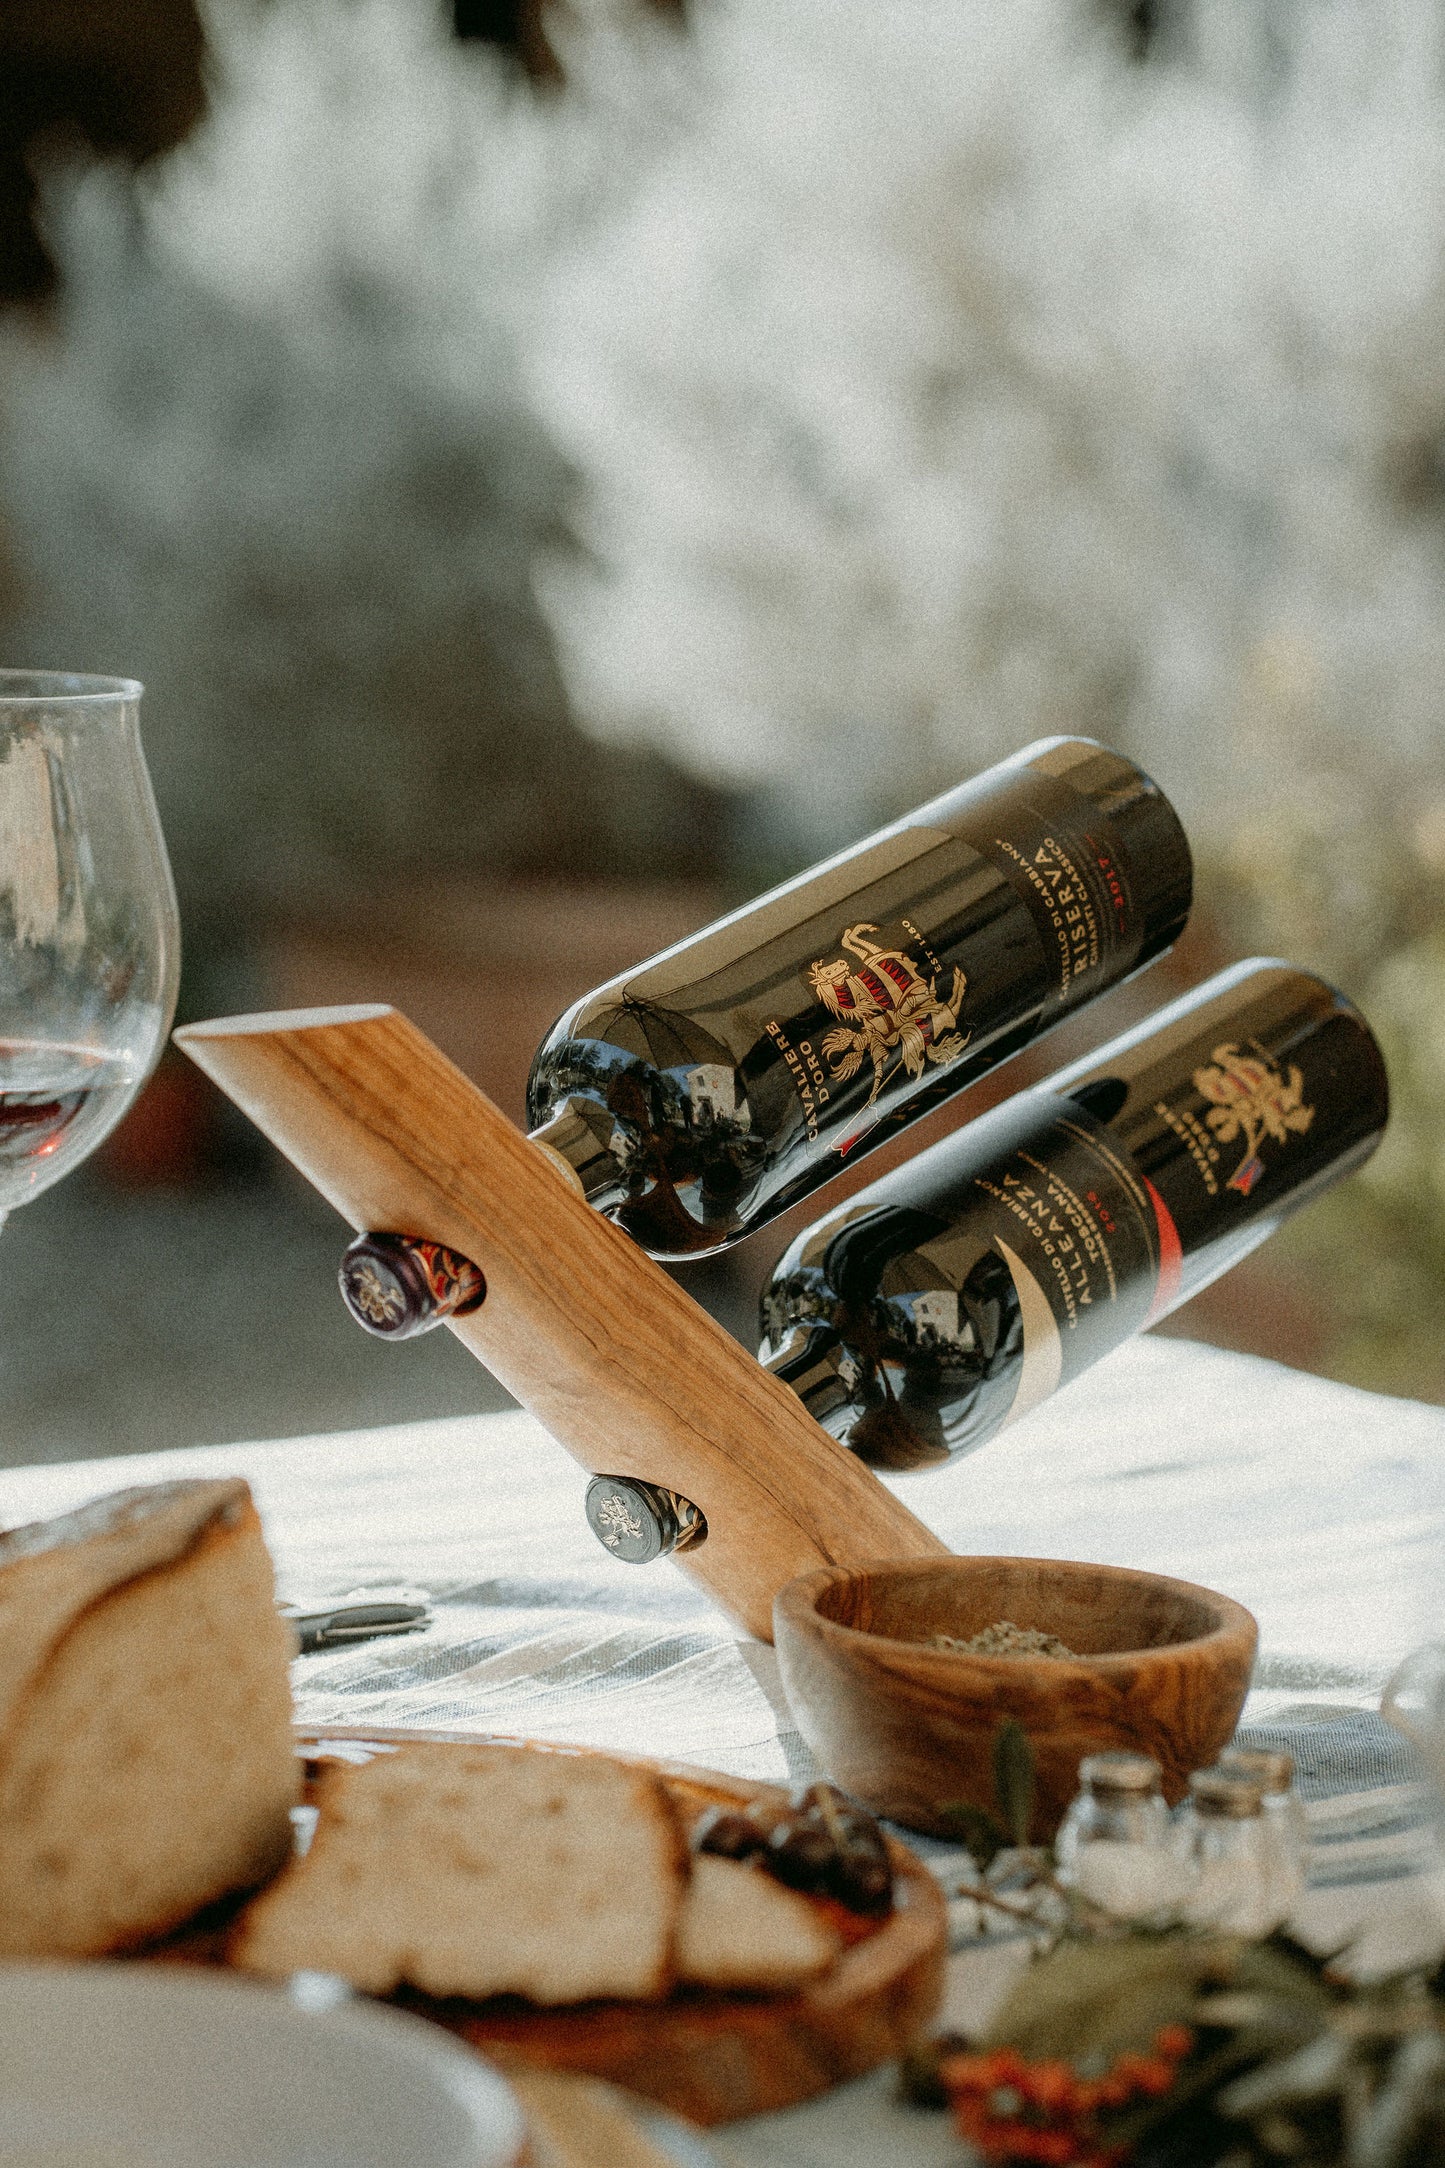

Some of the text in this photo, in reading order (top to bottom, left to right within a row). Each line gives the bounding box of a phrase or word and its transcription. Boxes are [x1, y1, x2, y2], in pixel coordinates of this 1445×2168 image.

[1000, 840, 1055, 908] GABBIANO
[1044, 837, 1099, 967] CHIANTI CLASSICO
[1035, 847, 1088, 975] RISERVA
[1051, 911, 1063, 928] DI
[902, 920, 942, 973] EST 1480
[766, 1020, 819, 1142] CAVALIERE
[799, 1040, 831, 1104] D'ORO
[980, 1180, 1044, 1237] GABBIANO
[1003, 1173, 1093, 1304] ALLEANZA
[1047, 1183, 1100, 1264] TOSCANA
[1041, 1238, 1056, 1256] DI
[1052, 1256, 1078, 1329] CASTELLO
